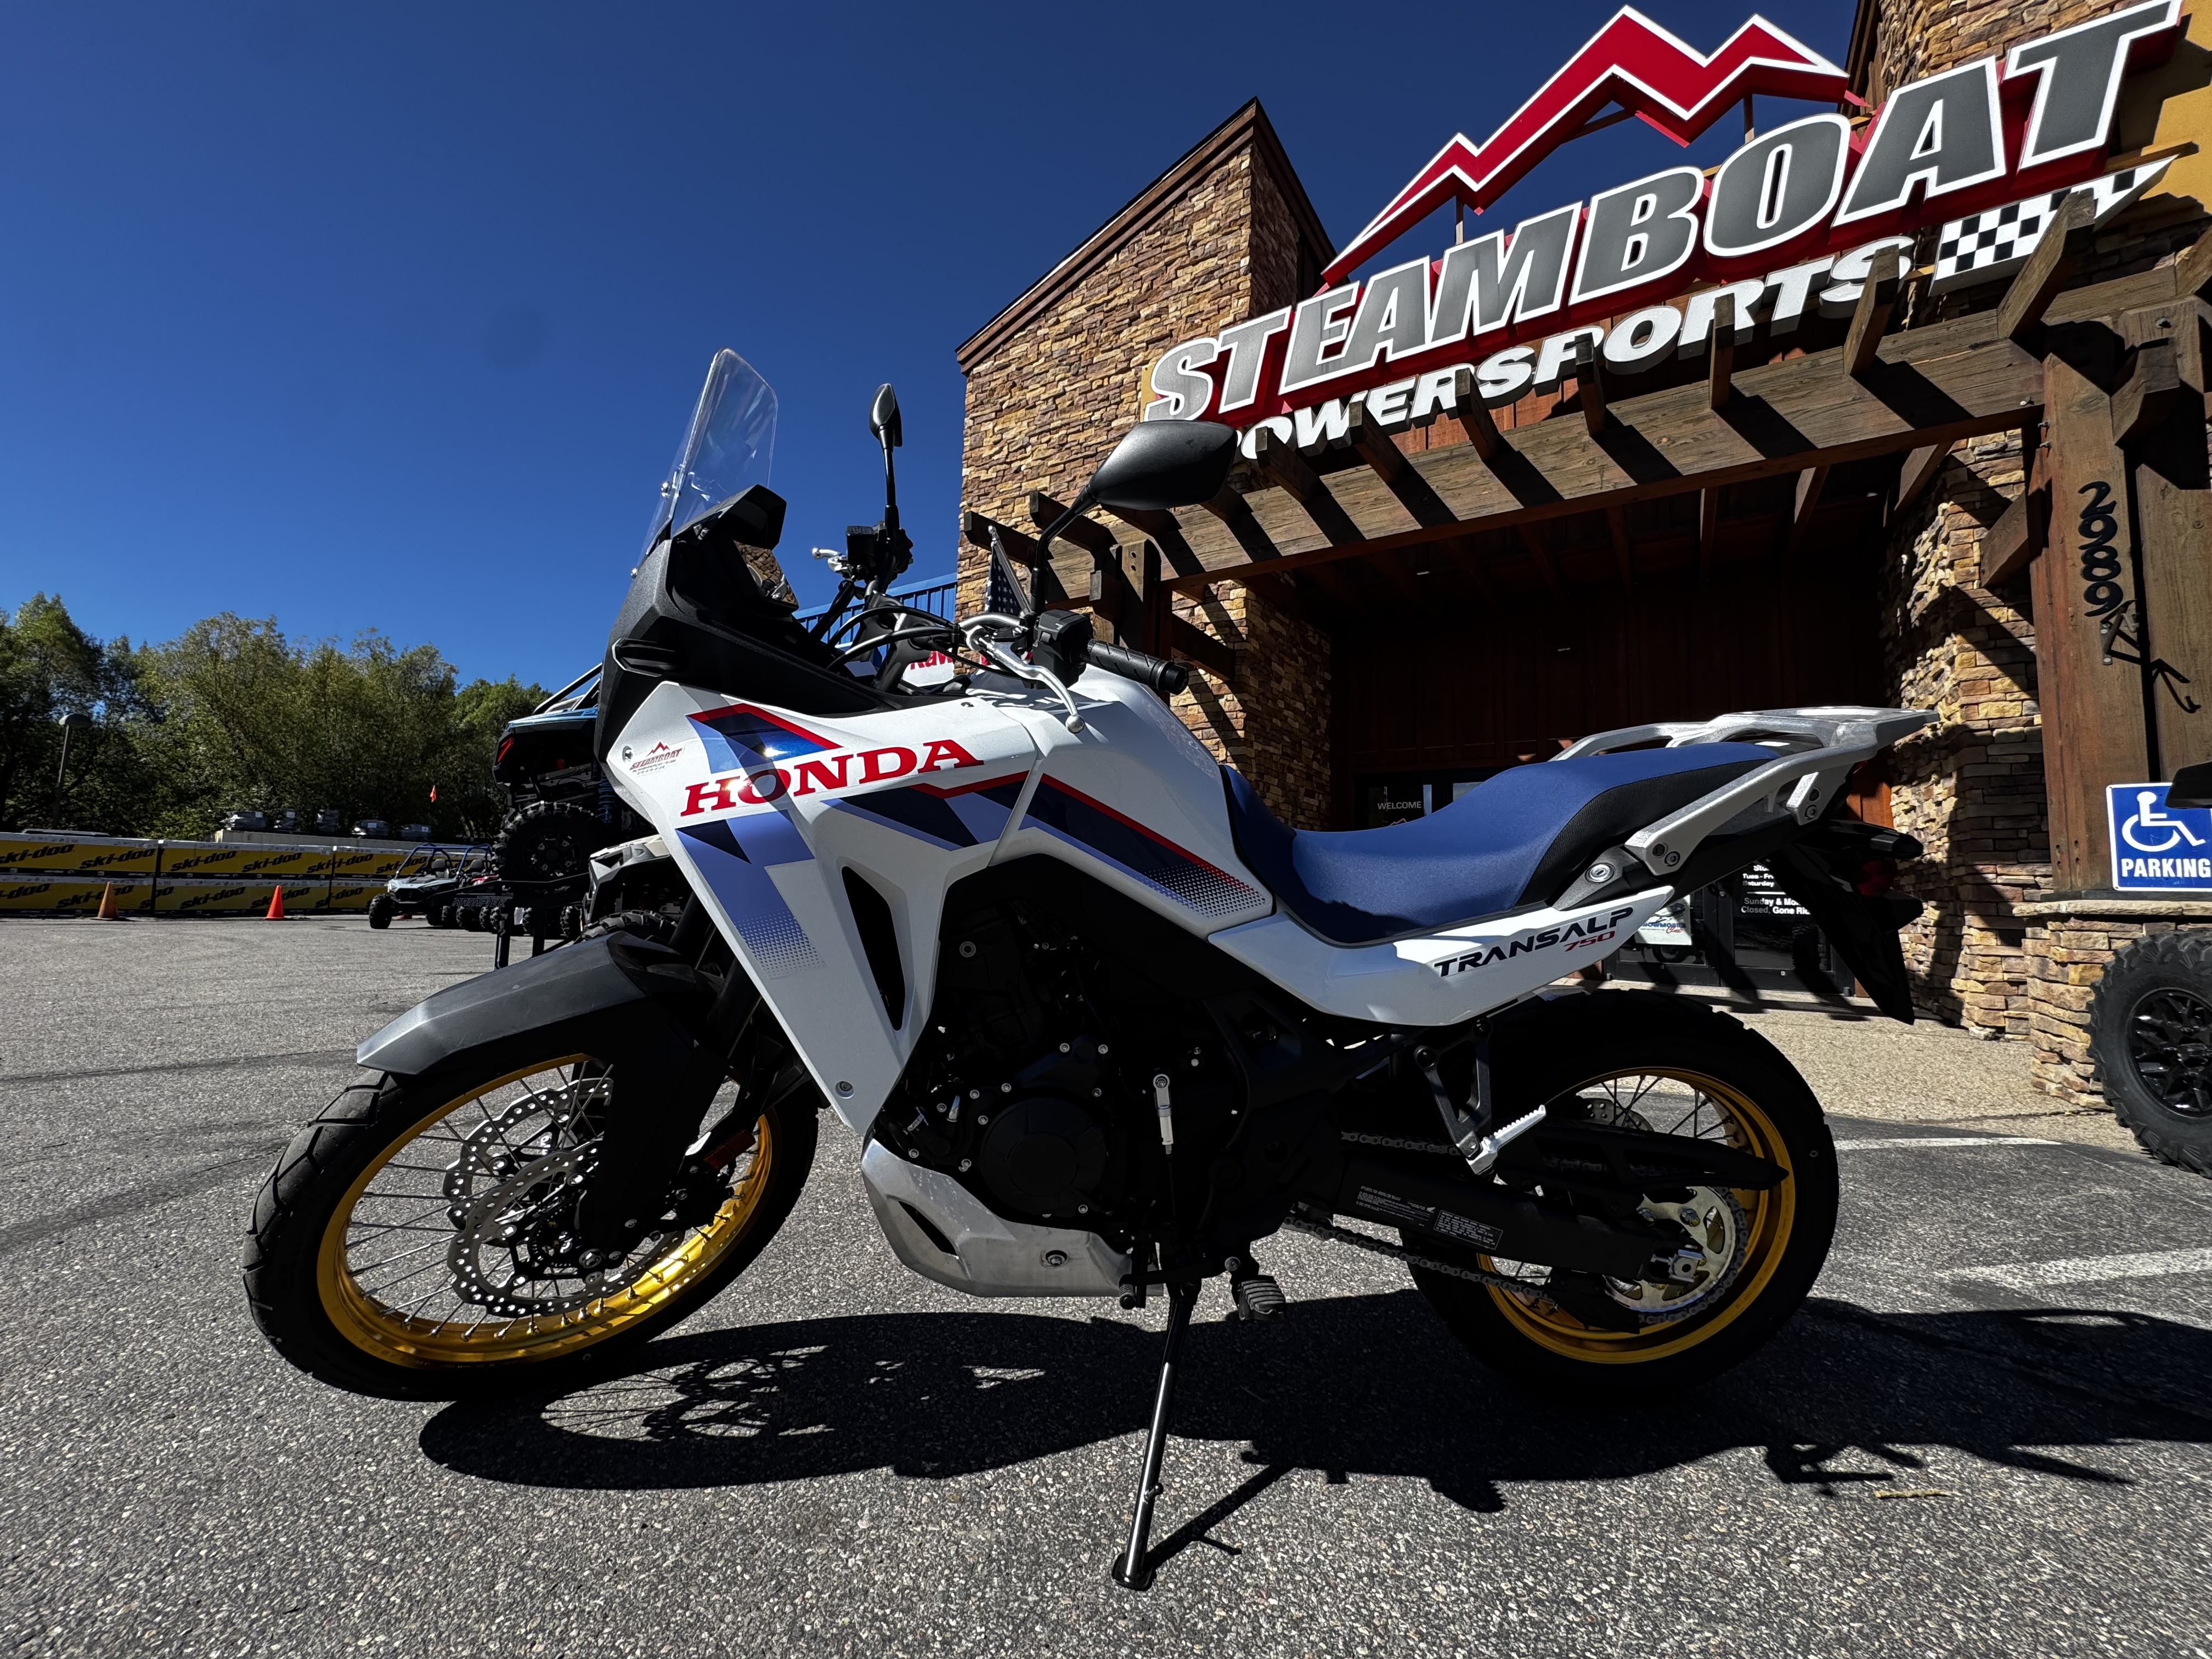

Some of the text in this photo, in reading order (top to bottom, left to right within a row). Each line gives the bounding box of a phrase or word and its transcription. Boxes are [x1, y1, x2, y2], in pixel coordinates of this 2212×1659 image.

[1144, 0, 2181, 421] STEAMBOAT
[1236, 236, 1915, 460] OWERSPORTS
[2078, 481, 2123, 617] 2989
[680, 740, 984, 816] HONDA
[1377, 801, 1422, 810] WELCOME
[80, 848, 156, 869] ski-doo
[171, 850, 237, 871] ski-doo
[241, 853, 302, 872] ski-doo
[2121, 858, 2211, 878] PARKING
[180, 887, 246, 909] ski-doo
[1744, 897, 1801, 907] Sunday & Mo
[1772, 906, 1795, 915] Gone
[1434, 907, 1633, 977] TRANSALP
[1564, 931, 1615, 952] 750
